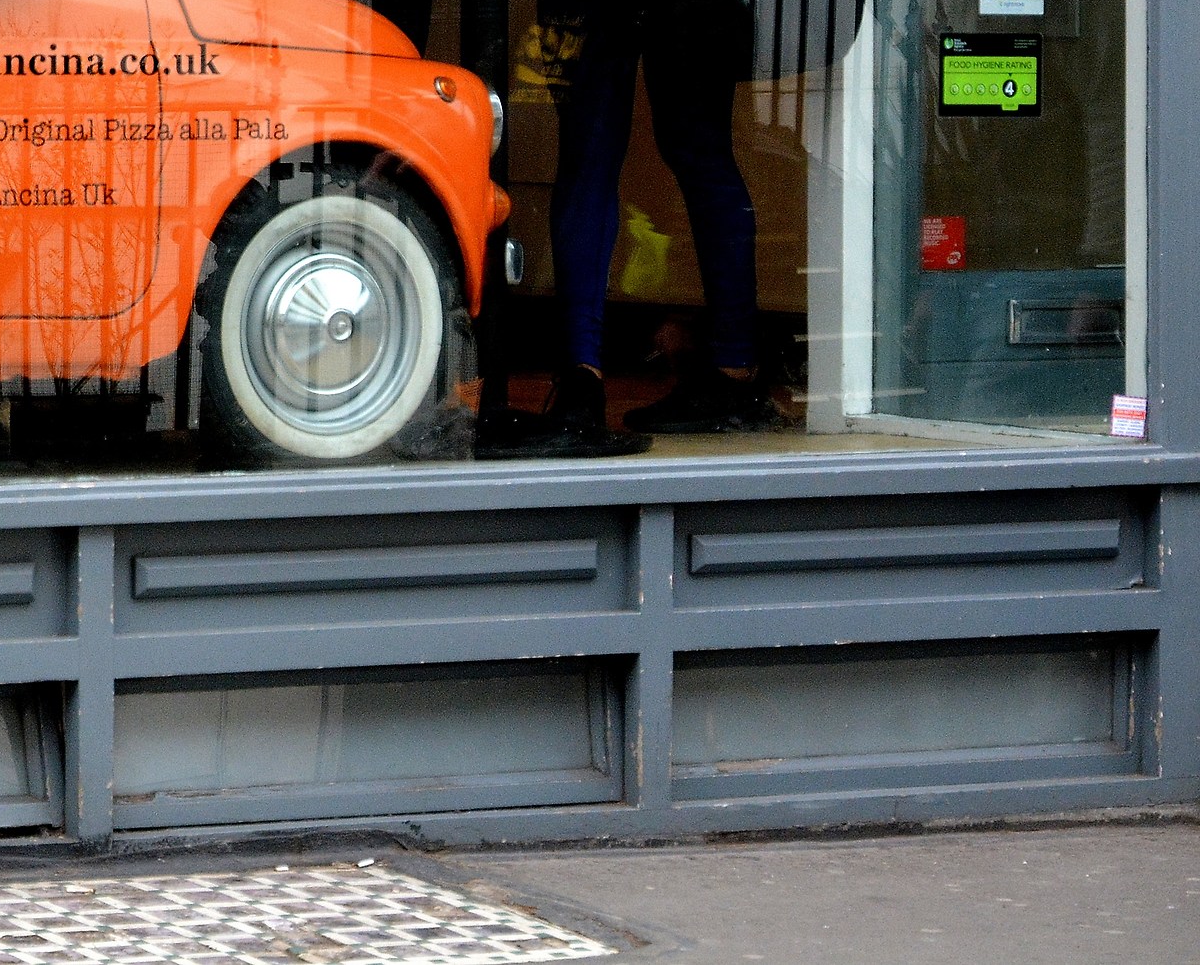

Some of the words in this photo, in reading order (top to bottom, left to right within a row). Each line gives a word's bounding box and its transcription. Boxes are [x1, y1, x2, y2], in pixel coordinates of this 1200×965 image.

[949, 61, 972, 69] FOOD
[973, 61, 1004, 69] HYGIENE
[1005, 61, 1032, 69] RATING
[1004, 81, 1015, 96] 4
[103, 119, 173, 143] Pizza
[179, 118, 227, 142] alla
[233, 119, 289, 144] Pala
[83, 182, 118, 207] Uk
